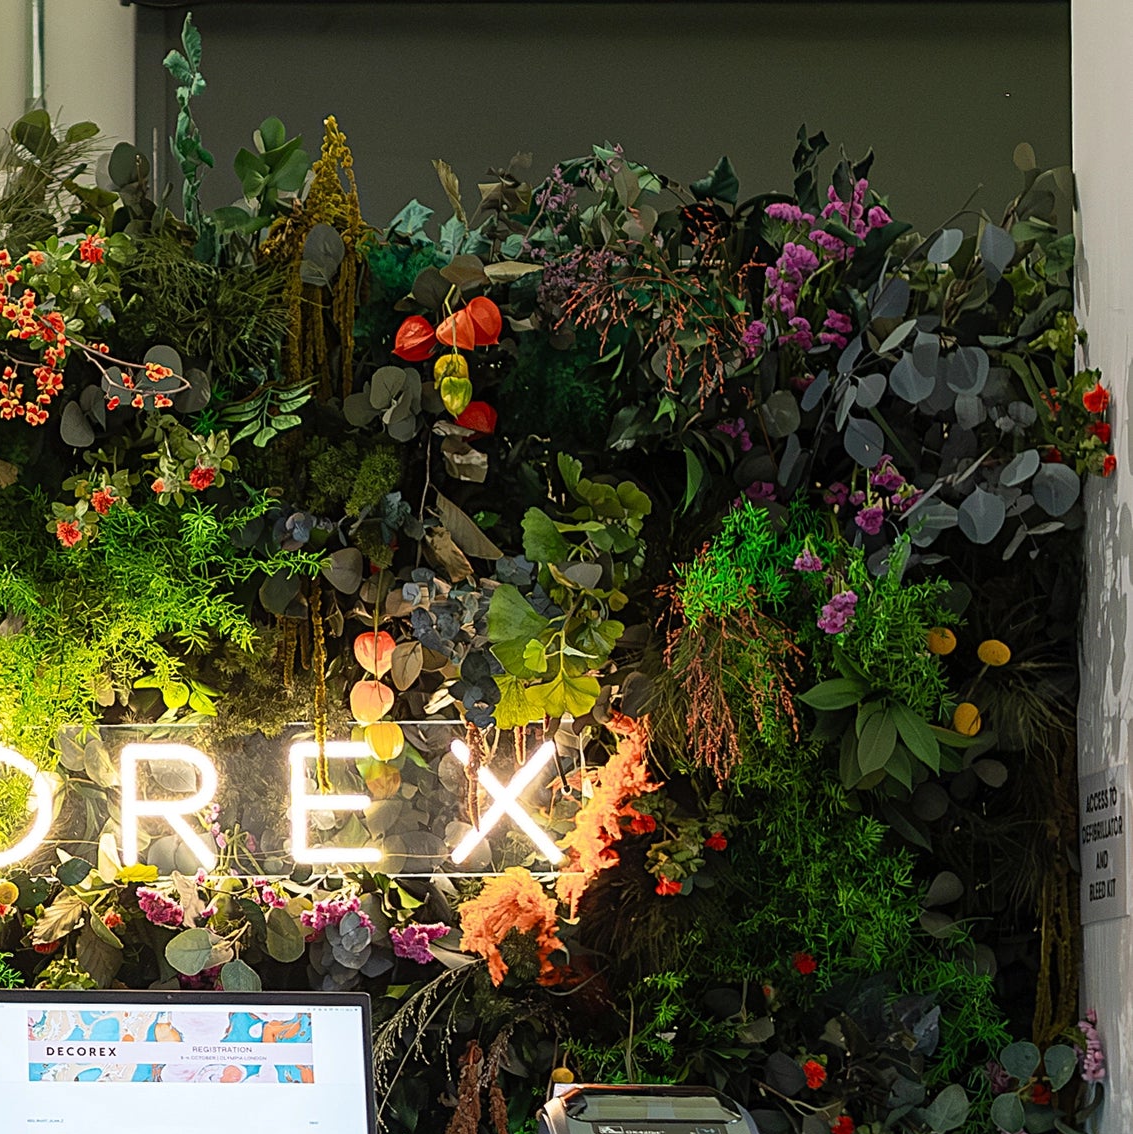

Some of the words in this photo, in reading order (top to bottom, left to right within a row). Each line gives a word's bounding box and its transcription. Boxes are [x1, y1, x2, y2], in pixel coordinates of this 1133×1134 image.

[1086, 788, 1108, 813] ACCESS
[1109, 786, 1117, 808] TO
[1082, 815, 1123, 844] DEFIBRILLATOR
[1096, 850, 1108, 872] AND
[1089, 879, 1106, 901] BLEED
[1107, 878, 1116, 898] KIT
[46, 1046, 117, 1057] DECOREX
[192, 1045, 253, 1053] REGISTRATION
